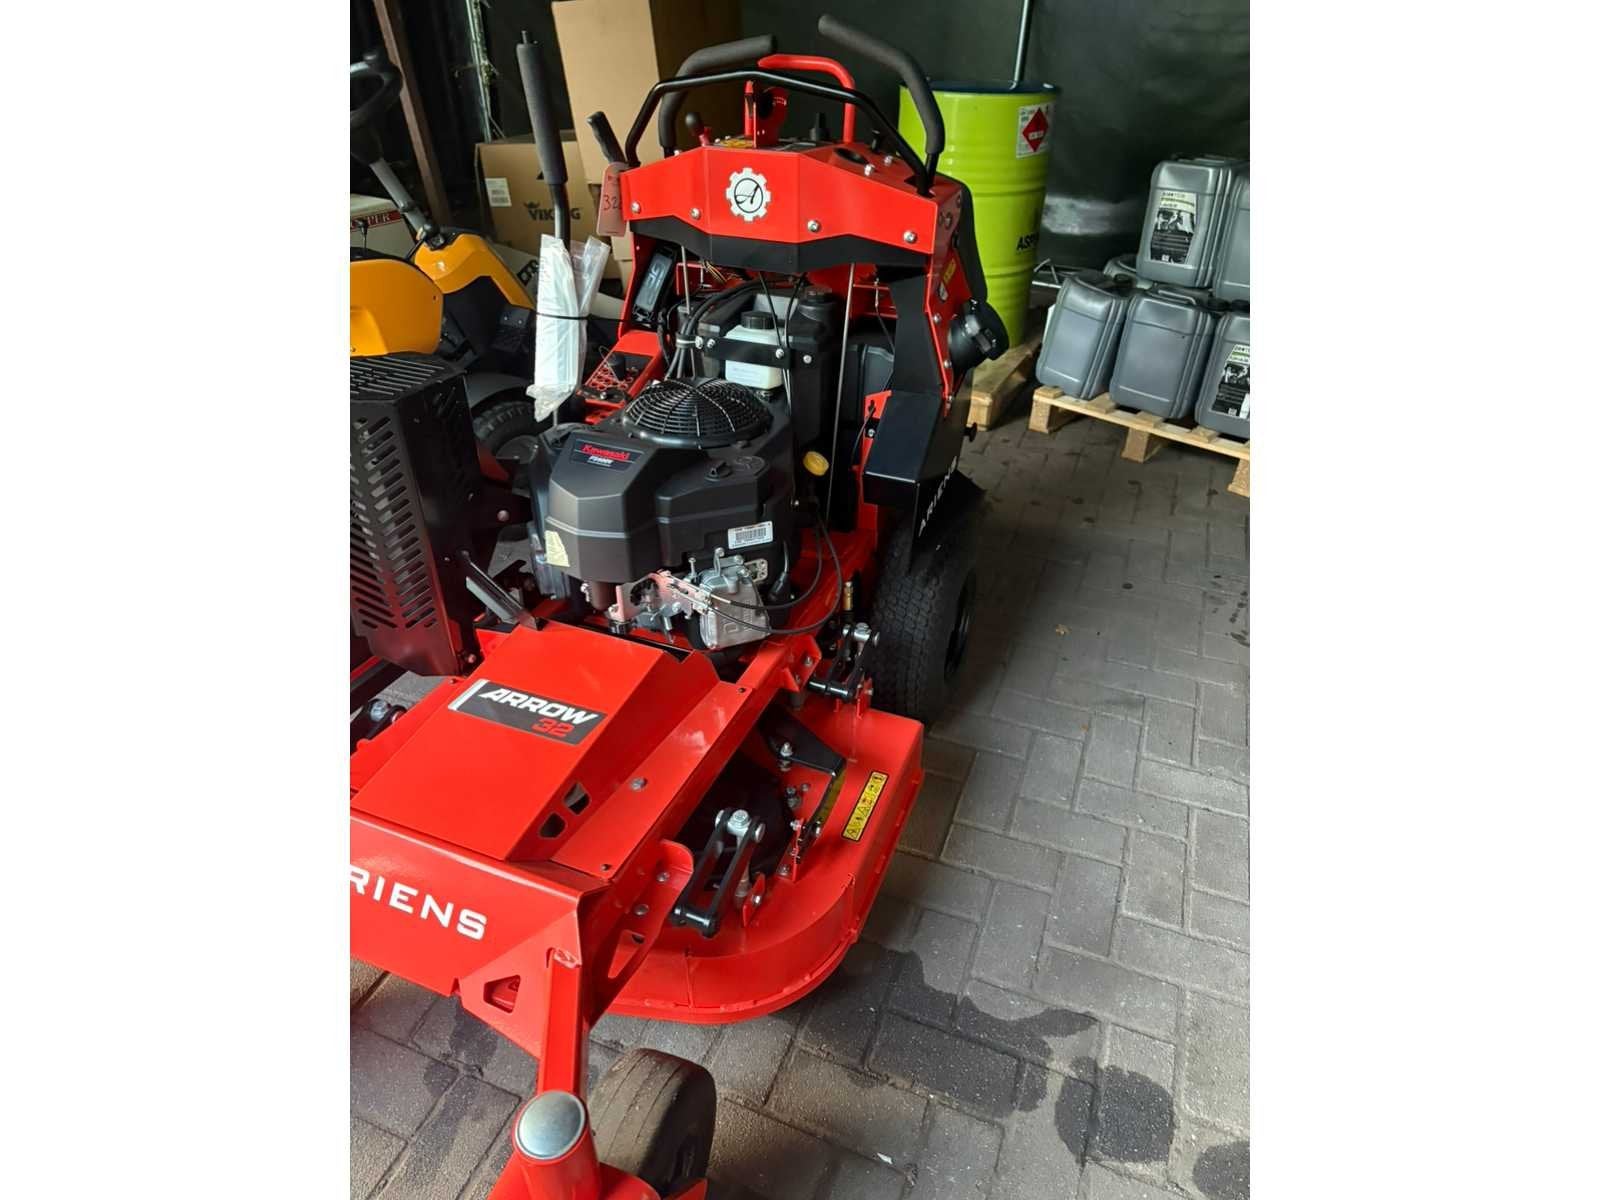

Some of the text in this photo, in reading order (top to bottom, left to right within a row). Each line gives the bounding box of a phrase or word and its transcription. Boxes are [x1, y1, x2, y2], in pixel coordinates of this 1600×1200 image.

[528, 206, 582, 221] VIKG
[582, 443, 630, 462] Kawasaki
[478, 688, 600, 725] ARROW
[531, 717, 576, 738] 32
